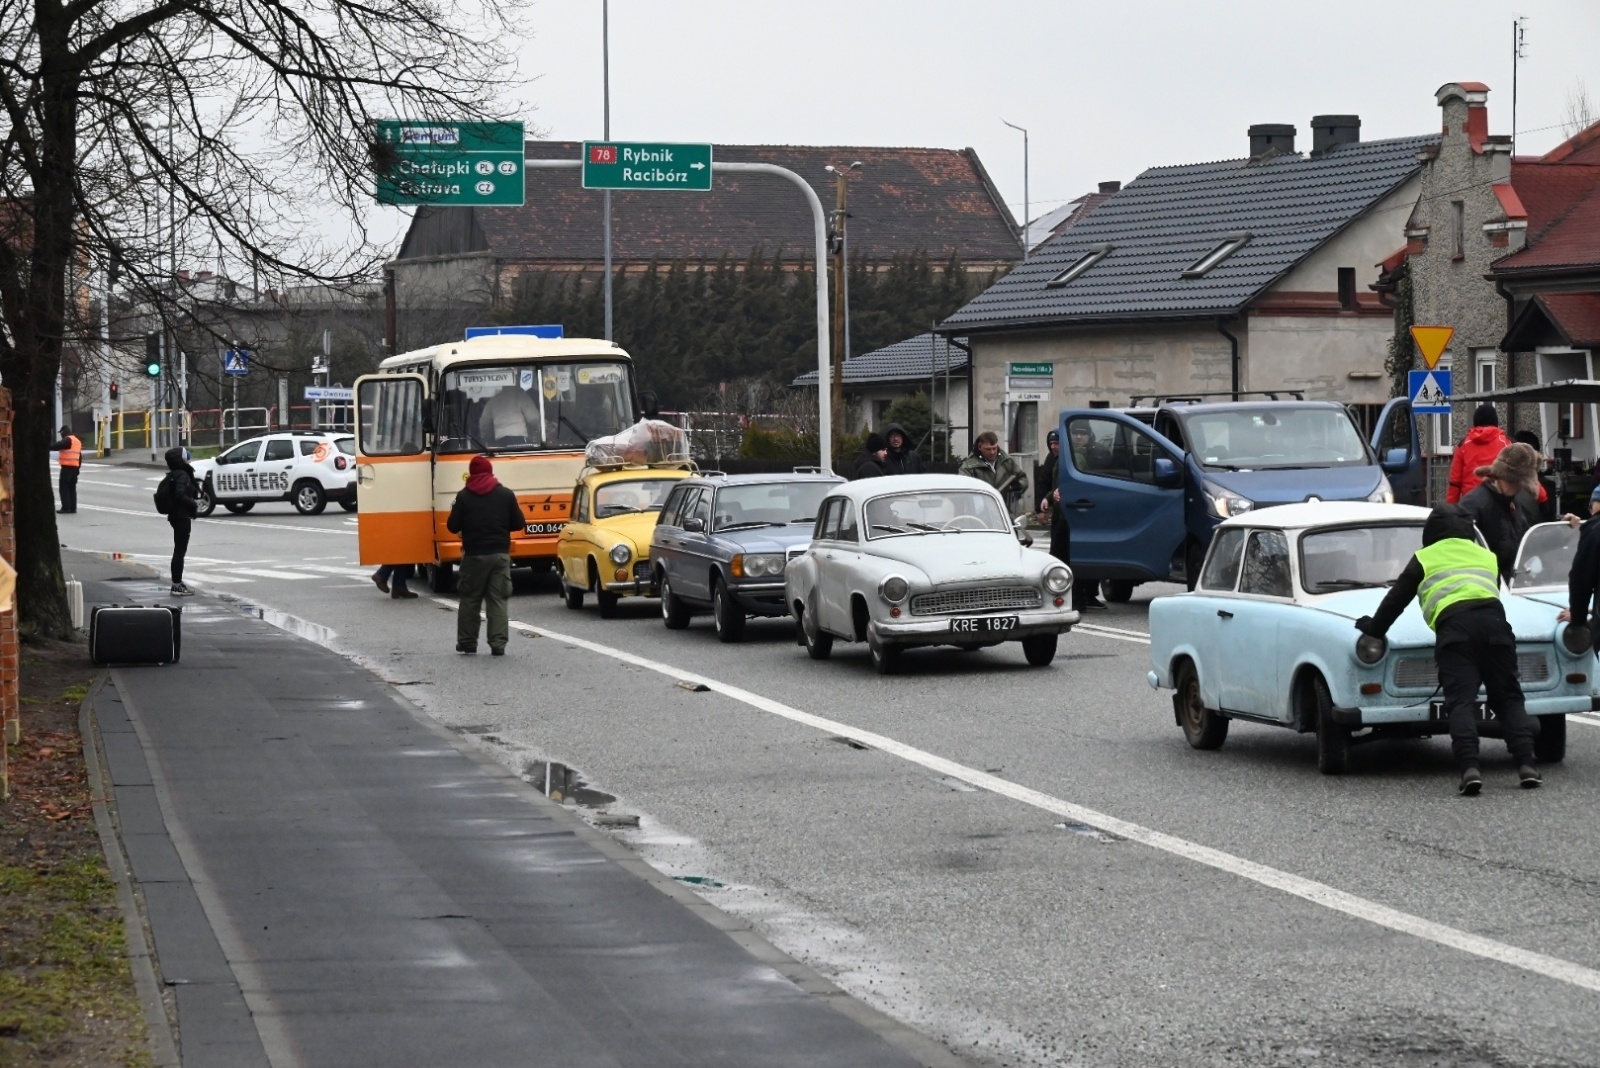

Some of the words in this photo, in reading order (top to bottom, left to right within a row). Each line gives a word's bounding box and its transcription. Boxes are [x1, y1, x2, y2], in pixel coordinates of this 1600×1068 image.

[596, 149, 611, 161] 78
[623, 147, 673, 165] Rybnik
[479, 163, 489, 172] PL
[500, 163, 513, 172] CZ
[623, 167, 688, 182] Racibórz
[478, 183, 491, 192] CZ
[463, 374, 508, 383] TURYSTYCZNY
[323, 390, 352, 398] Dworzec
[216, 471, 289, 491] HUNTERS
[526, 524, 544, 533] KDO
[952, 618, 979, 633] KRE
[986, 617, 1017, 631] 1827
